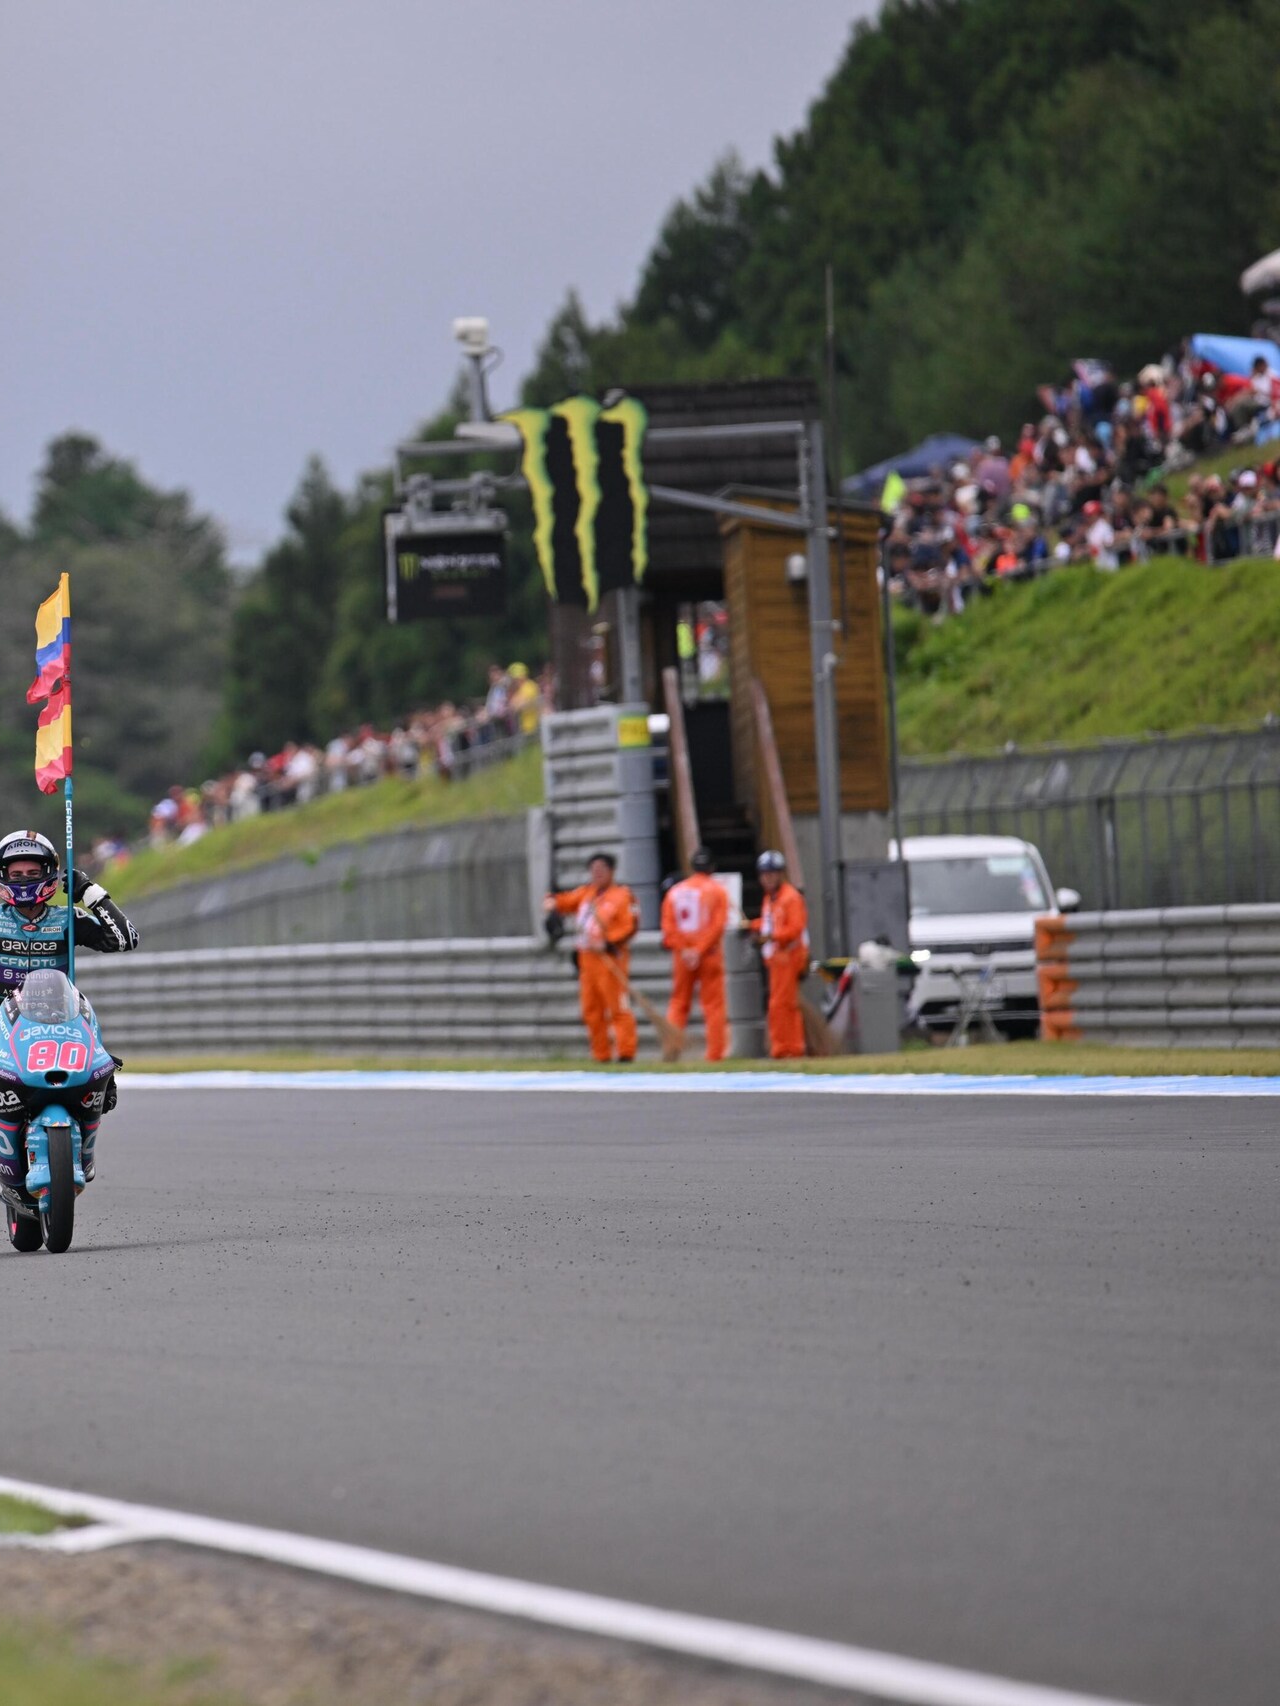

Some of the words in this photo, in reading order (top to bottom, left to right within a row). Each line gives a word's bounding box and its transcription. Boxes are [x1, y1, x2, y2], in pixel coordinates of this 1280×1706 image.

[65, 800, 73, 849] CFMOTO
[7, 841, 37, 850] AIROH
[1, 940, 57, 951] gaviota
[0, 956, 57, 967] CFMOTO
[20, 1025, 82, 1041] gaviota
[26, 1040, 88, 1073] 80
